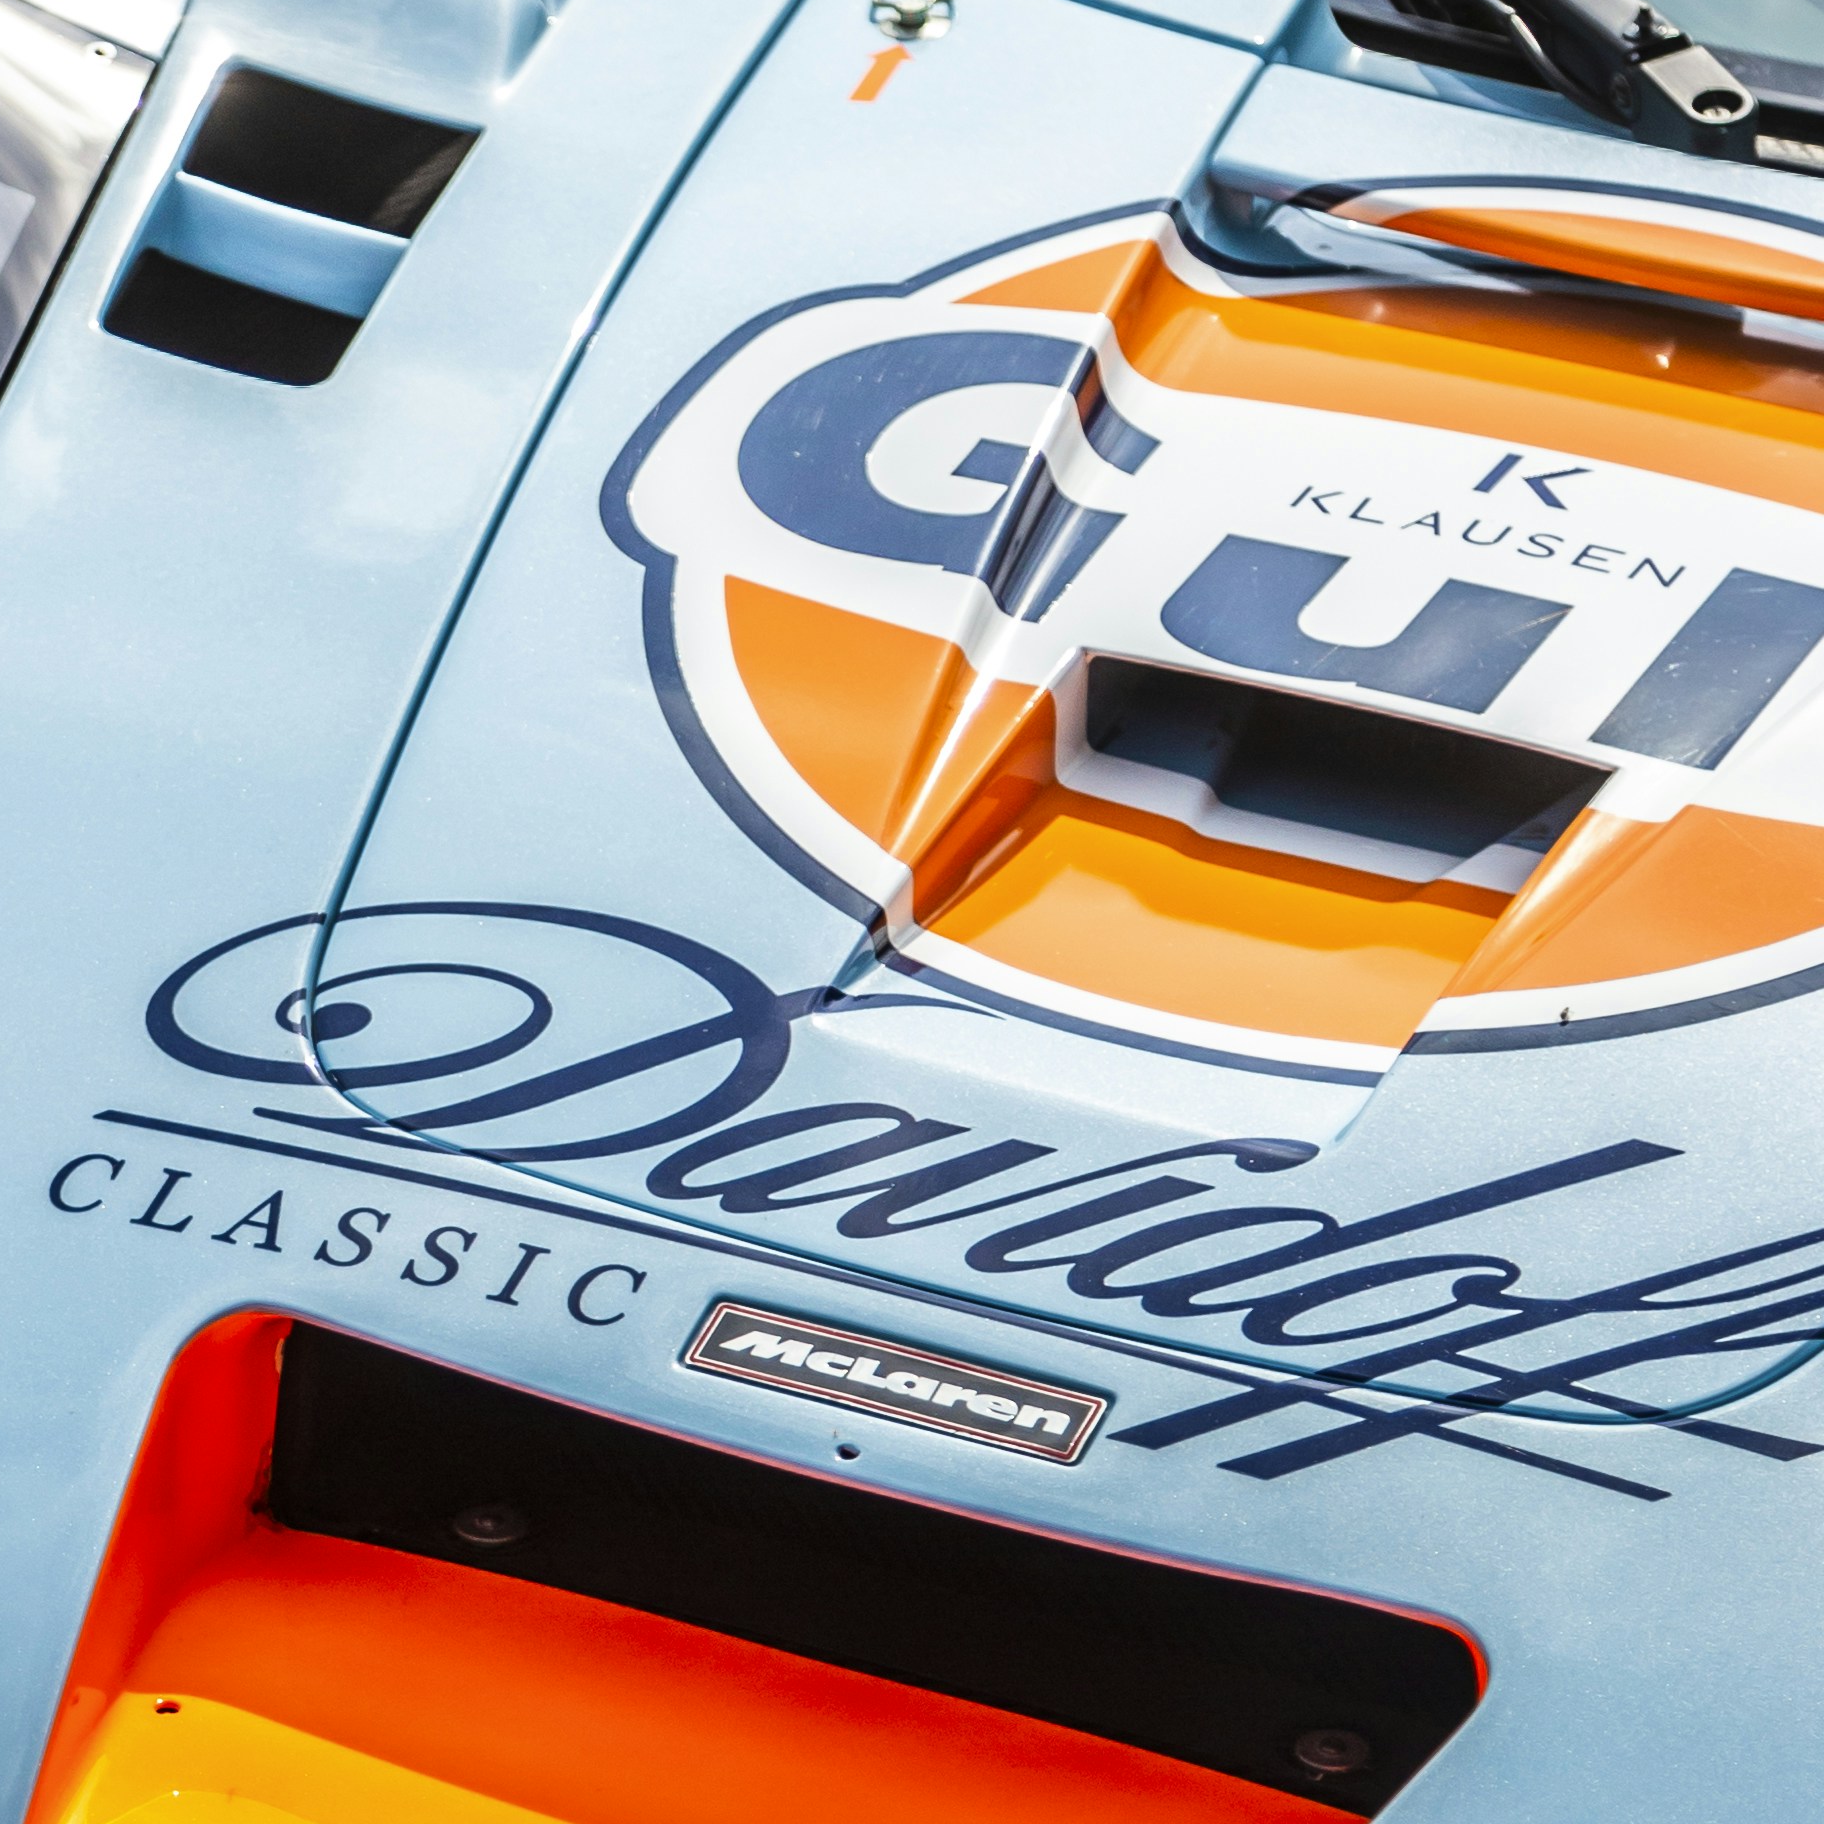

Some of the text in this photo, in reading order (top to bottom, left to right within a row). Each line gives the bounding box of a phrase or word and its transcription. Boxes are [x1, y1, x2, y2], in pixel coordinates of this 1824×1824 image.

[1472, 453, 1595, 511] K
[1290, 485, 1687, 588] KLAUSEN
[48, 1153, 647, 1326] CLASSIC
[719, 1330, 1072, 1436] McLaren
